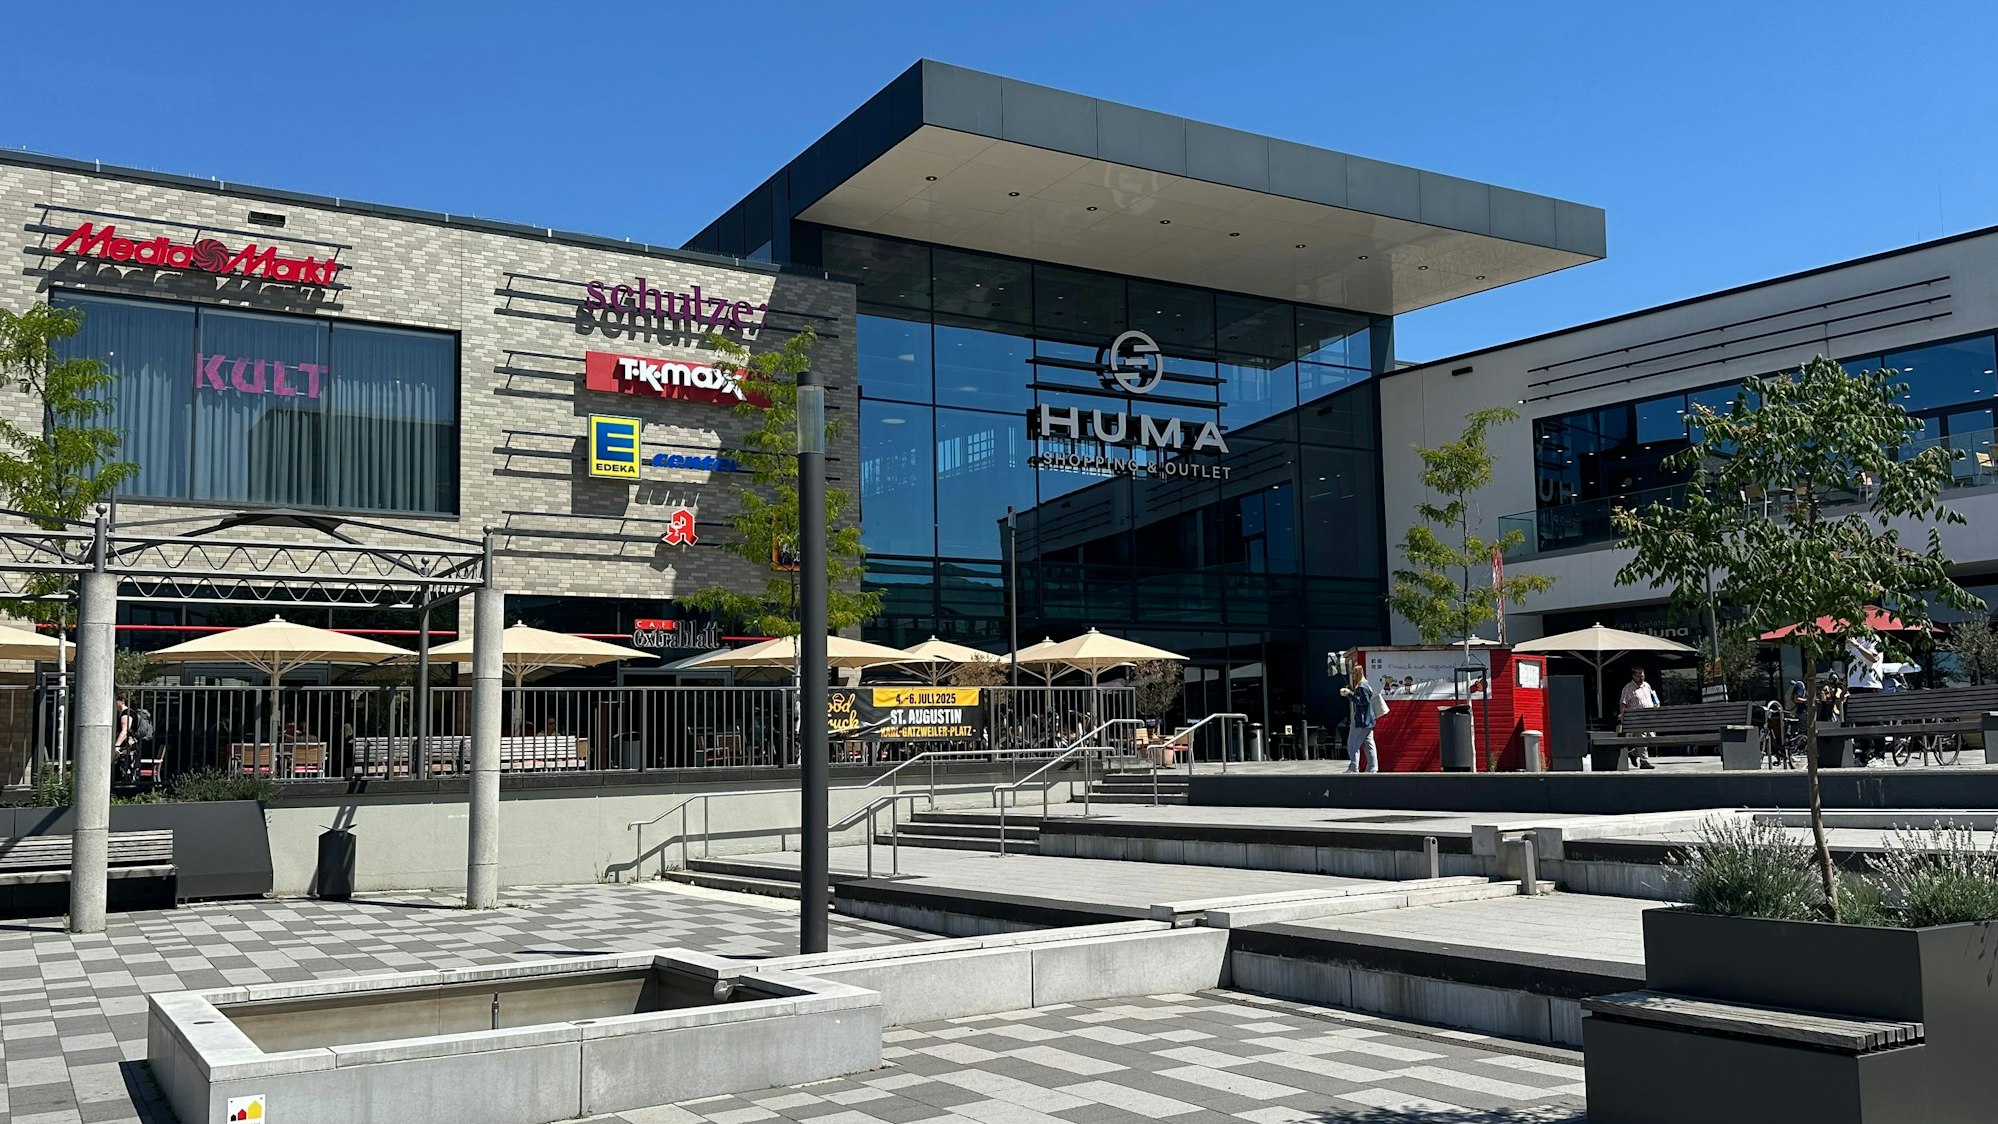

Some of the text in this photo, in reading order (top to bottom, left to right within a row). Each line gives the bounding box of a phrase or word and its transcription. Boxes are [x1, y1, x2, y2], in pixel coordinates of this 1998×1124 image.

[195, 353, 329, 398] KULT
[1040, 403, 1230, 454] HUMA
[596, 463, 636, 474] EDEKA
[1043, 451, 1231, 480] SHOPPING & OUTLET
[633, 620, 723, 649] extrablatt
[918, 693, 934, 704] JULI
[935, 693, 956, 704] 2025
[890, 709, 962, 725] ST. AUGUSTIN
